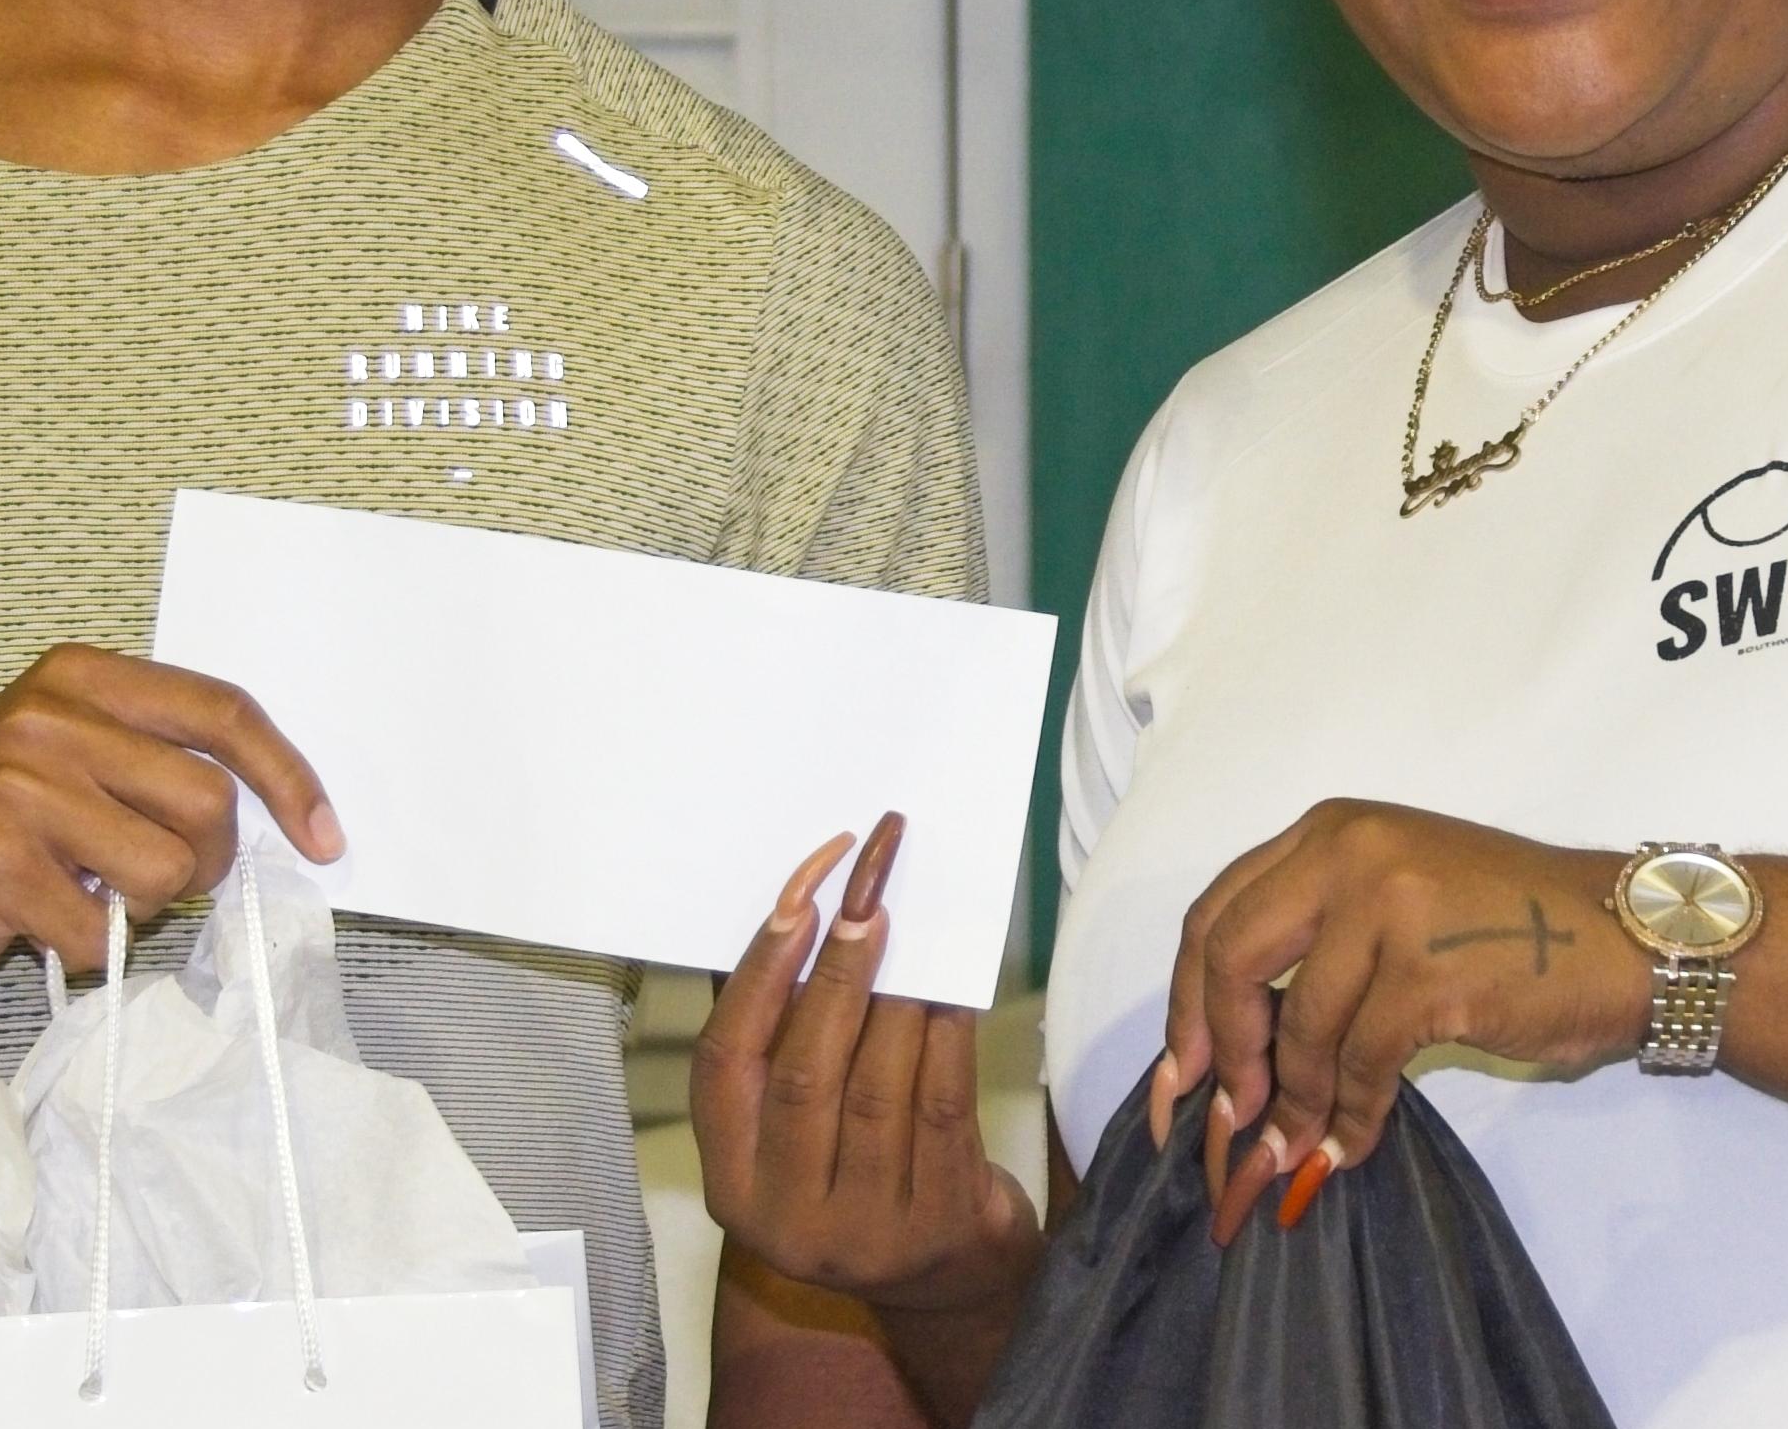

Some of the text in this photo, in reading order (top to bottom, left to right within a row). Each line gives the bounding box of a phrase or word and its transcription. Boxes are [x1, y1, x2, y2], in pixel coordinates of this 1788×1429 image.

[404, 305, 510, 331] NIKE
[351, 352, 564, 379] RUNNING
[351, 400, 568, 428] DIVISION
